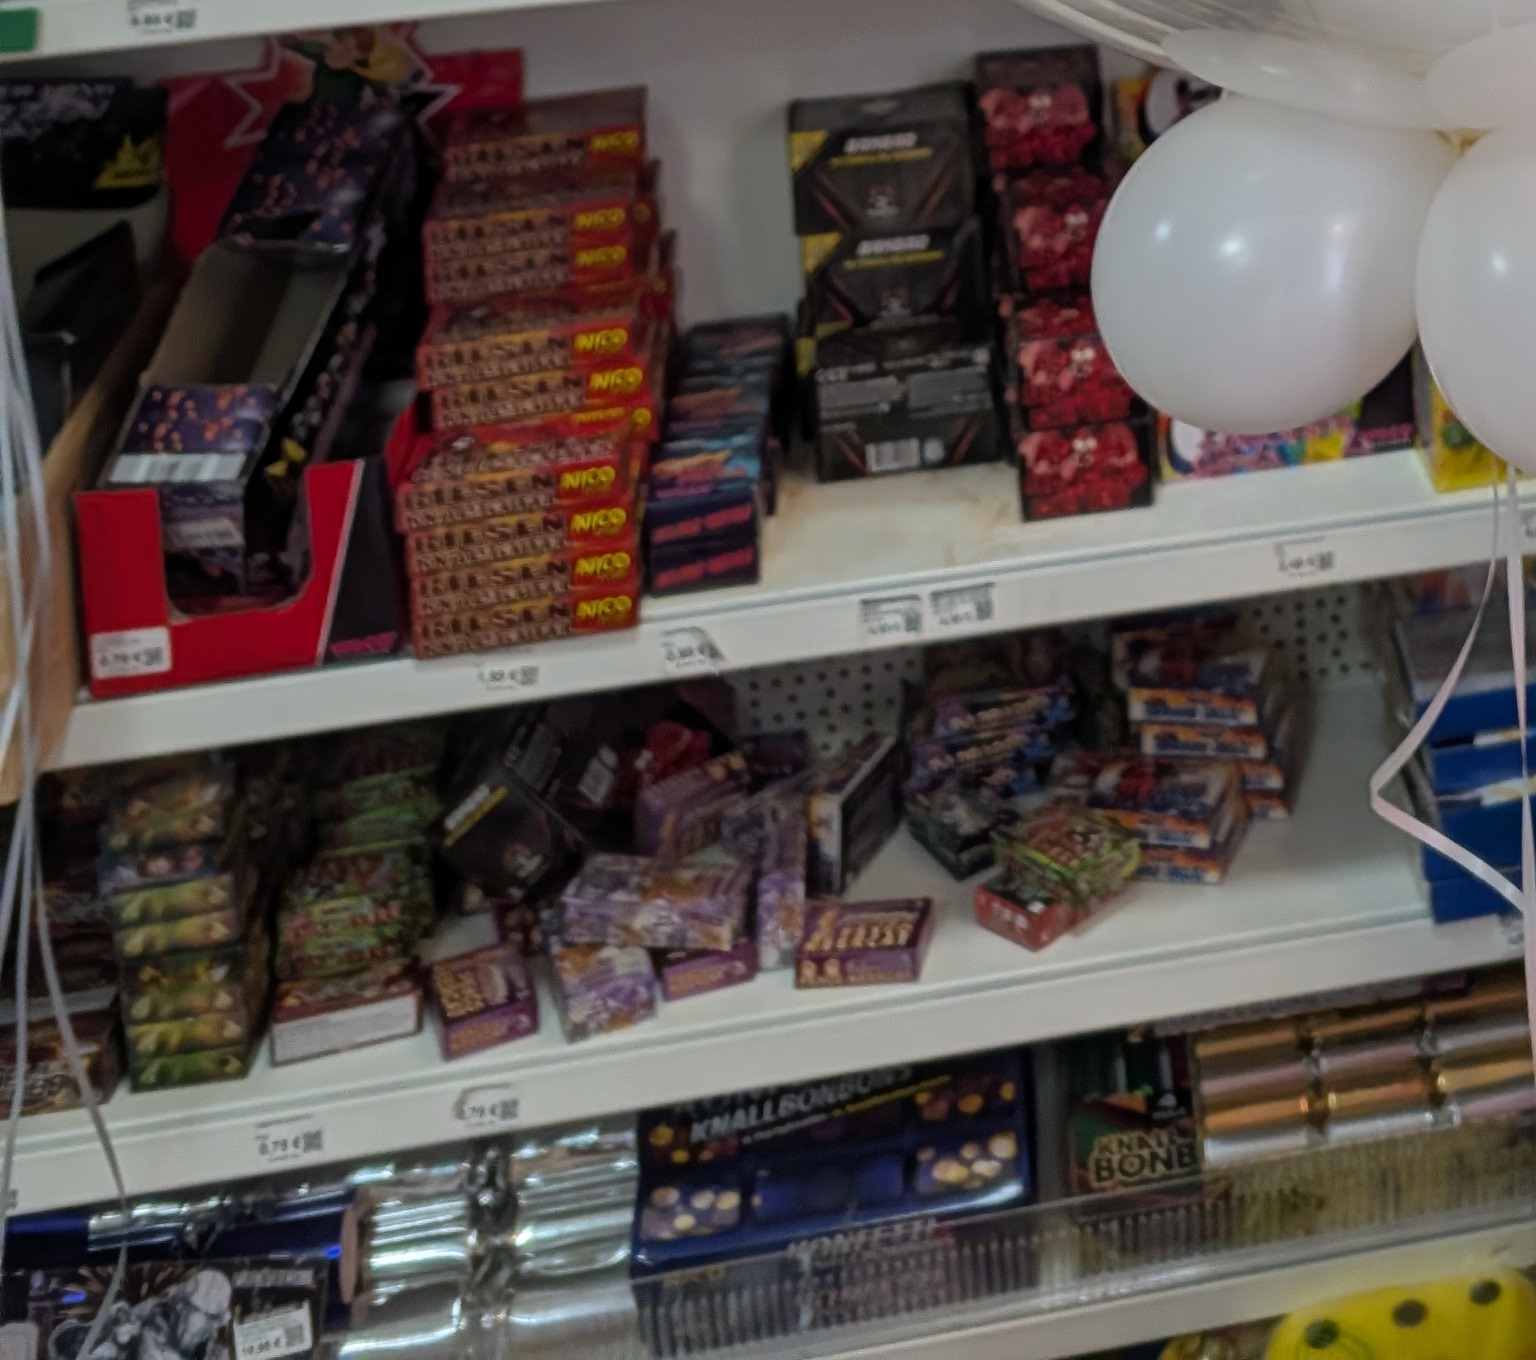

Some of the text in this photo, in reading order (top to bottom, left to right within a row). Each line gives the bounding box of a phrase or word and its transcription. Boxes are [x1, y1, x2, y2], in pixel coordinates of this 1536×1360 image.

[574, 328, 628, 352] NICO
[589, 367, 643, 390] NICO
[560, 466, 616, 488] NICO
[571, 508, 627, 531] NICO
[575, 552, 631, 576] NICO
[576, 595, 633, 618] NICO
